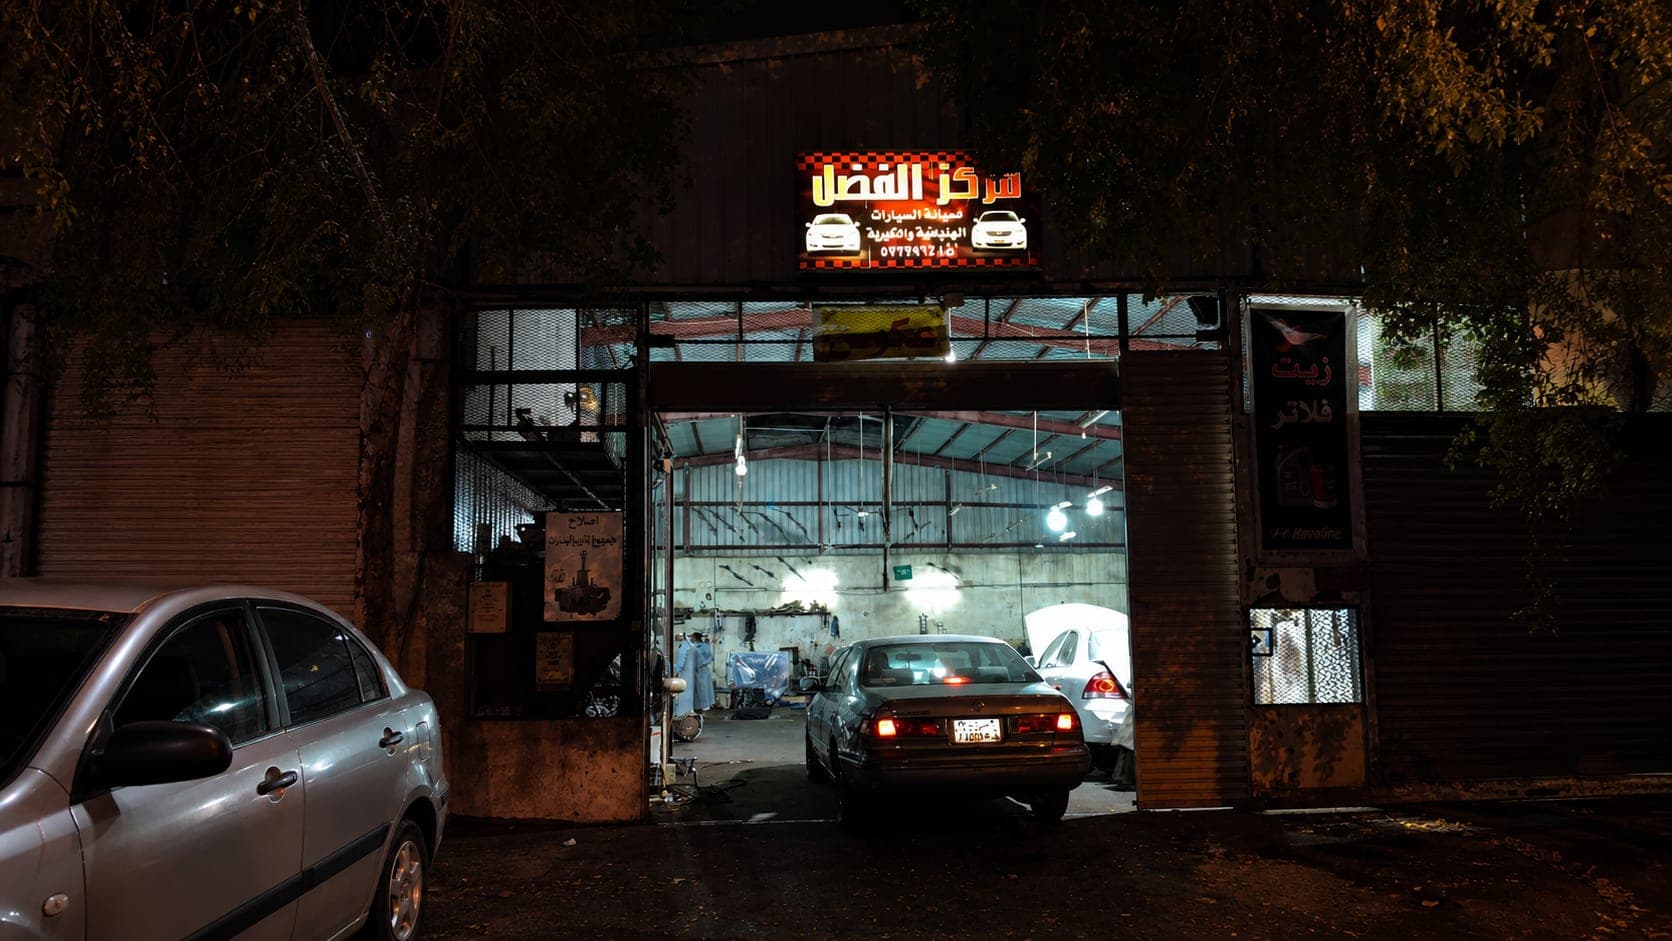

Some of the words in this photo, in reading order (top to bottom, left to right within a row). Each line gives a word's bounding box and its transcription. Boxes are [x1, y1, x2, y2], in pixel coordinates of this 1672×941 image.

[812, 163, 924, 206] الفضل
[871, 209, 922, 223] السيارات
[1271, 355, 1333, 386] زيت
[1266, 399, 1334, 430] فلاتر
